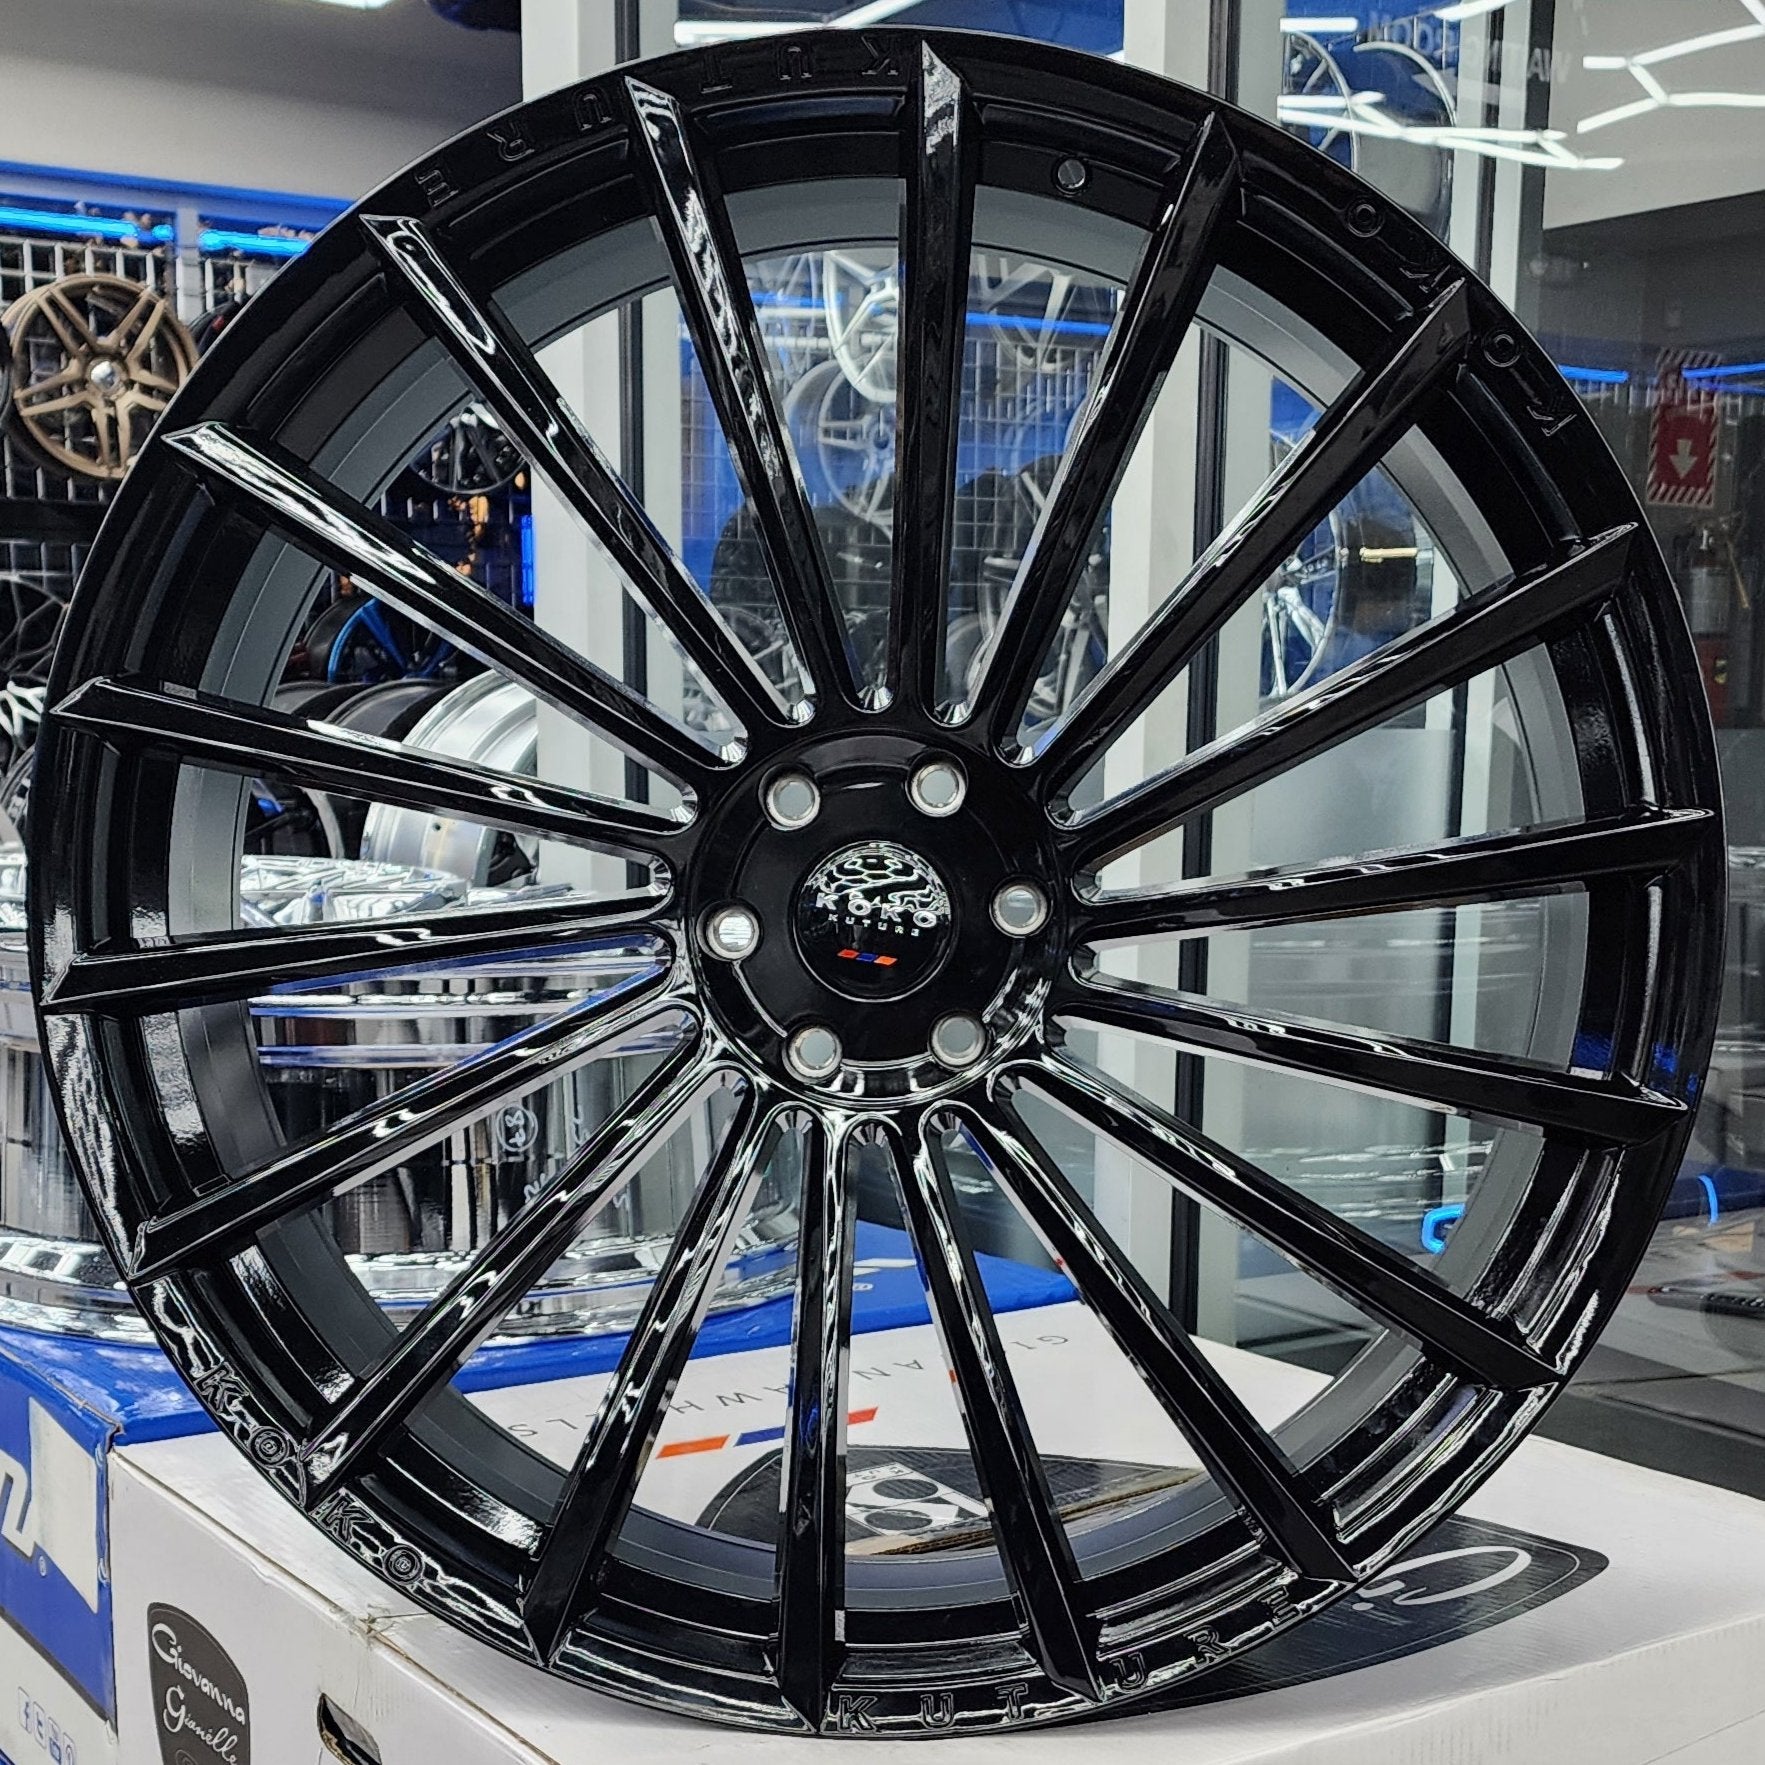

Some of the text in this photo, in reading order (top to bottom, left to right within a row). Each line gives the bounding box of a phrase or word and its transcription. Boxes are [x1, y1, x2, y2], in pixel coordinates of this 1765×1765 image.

[415, 36, 899, 207] KUTURE
[814, 892, 937, 928] KOKO
[827, 913, 920, 937] KUTURE
[151, 1622, 246, 1725] Giovanna
[836, 1585, 1297, 1734] KUTURE
